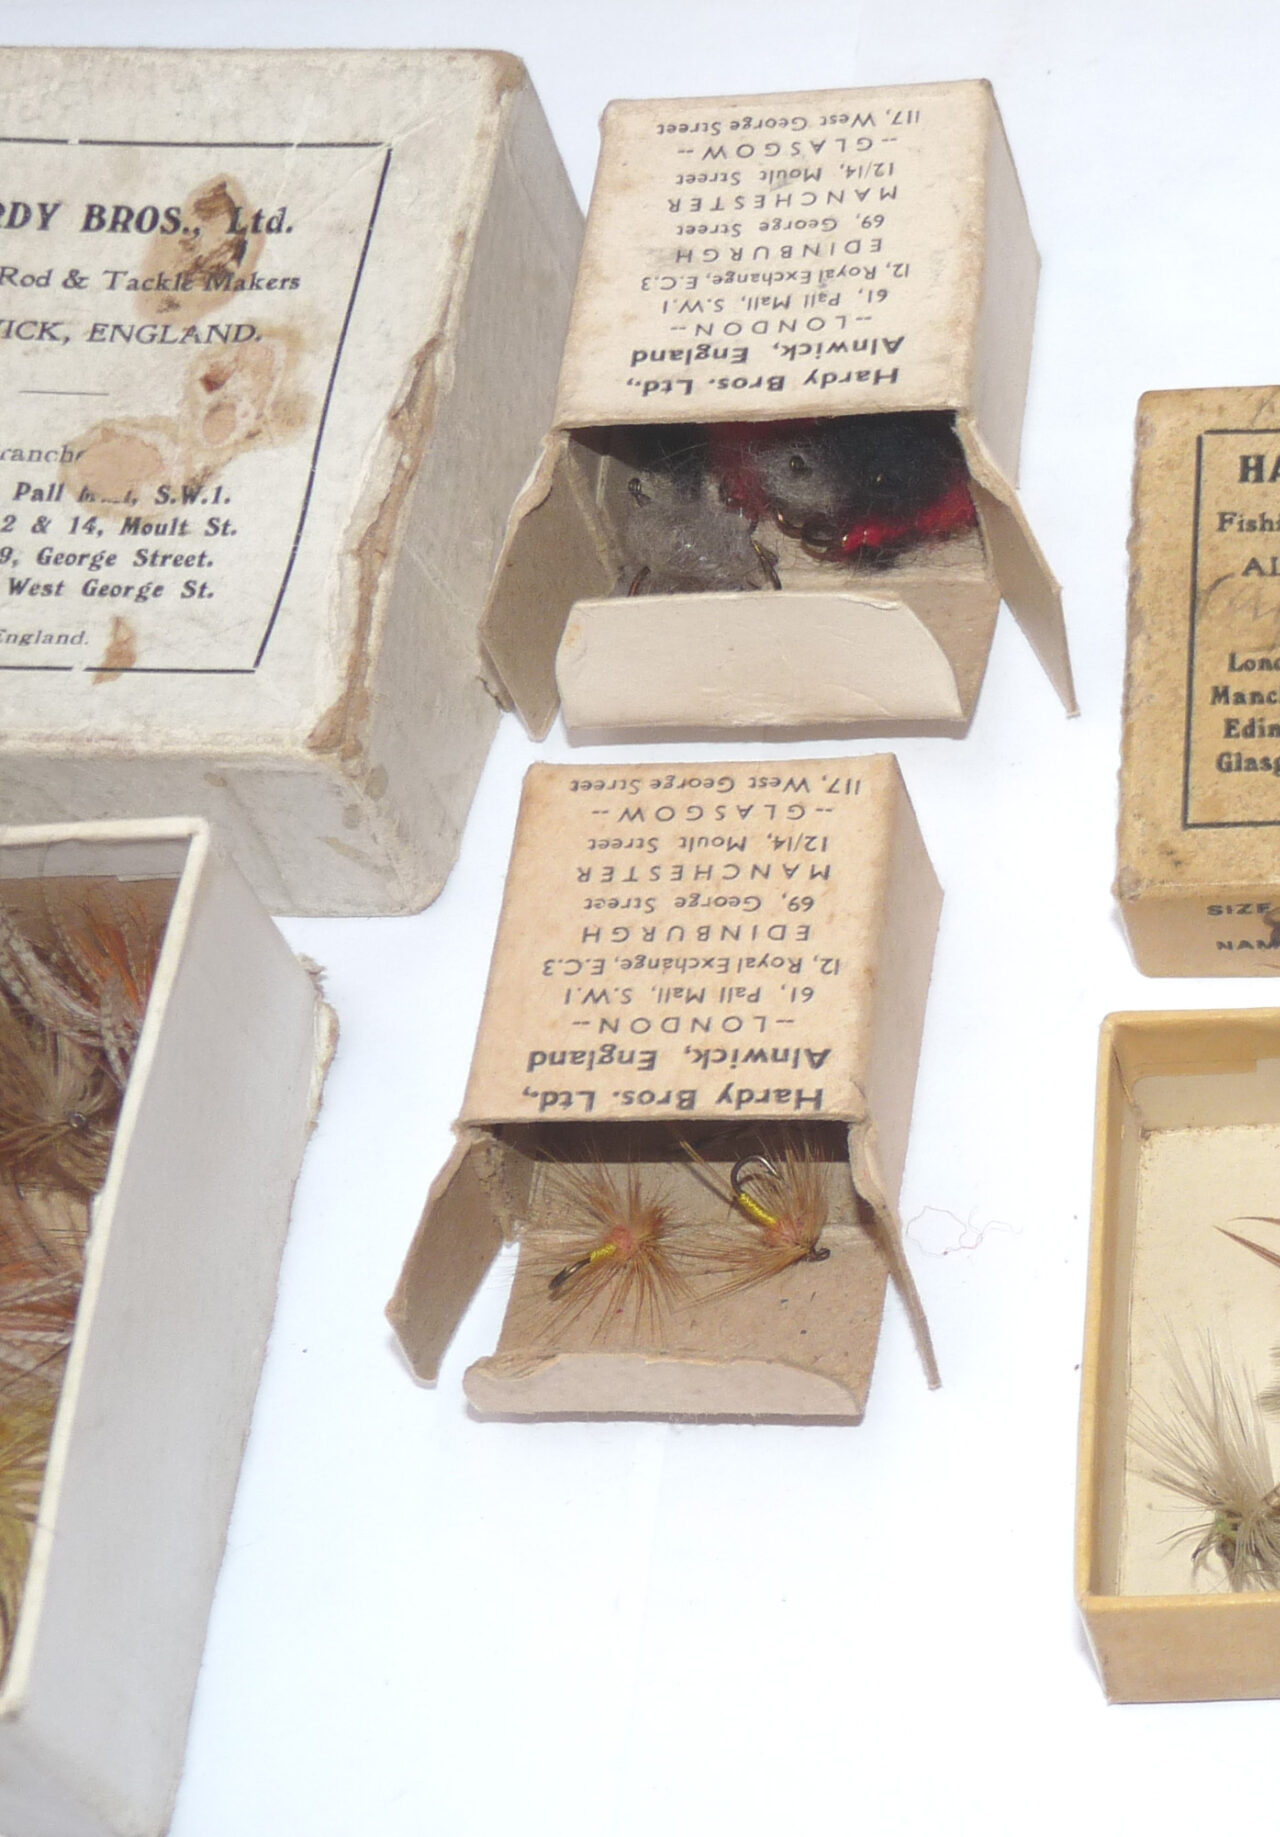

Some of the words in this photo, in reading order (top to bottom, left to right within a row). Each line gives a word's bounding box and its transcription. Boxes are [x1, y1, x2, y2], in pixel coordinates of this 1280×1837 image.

[730, 116, 808, 131] George
[820, 113, 876, 128] West
[886, 109, 920, 125] 117,
[657, 121, 721, 136] Street
[676, 172, 740, 186] Street
[760, 167, 822, 184] Moult
[840, 162, 894, 179] 12/14,
[668, 185, 897, 213] MANCHESTER
[80, 203, 201, 237] BROS.,
[225, 205, 294, 235] Ltd.
[759, 218, 837, 232] George
[856, 214, 885, 229] 69,
[677, 223, 742, 238] Street
[675, 238, 882, 264] EDINBURGH
[0, 266, 53, 288] Rod
[62, 269, 89, 289] &
[103, 269, 193, 291] Tackle
[203, 270, 300, 292] Makers
[706, 270, 811, 286] Exchange,
[818, 265, 876, 283] Royal
[886, 262, 910, 278] 12,
[741, 295, 791, 311] Mall,
[804, 292, 841, 308] Pall
[859, 288, 888, 303] 61,
[86, 322, 262, 344] ENGLAND.
[631, 344, 749, 367] England
[773, 336, 905, 361] Alnwick,
[627, 378, 693, 397] Ltd.,
[709, 376, 785, 391] Bros.
[804, 368, 899, 389] Hardy
[12, 482, 64, 502] Pall
[31, 515, 51, 534] &
[70, 516, 103, 537] 14,
[120, 516, 188, 536] Moult
[204, 517, 237, 536] St.
[36, 547, 117, 571] George
[133, 549, 213, 568] Street.
[9, 577, 64, 596] West
[82, 578, 164, 602] George
[181, 580, 213, 598] St.
[570, 779, 641, 795] Street
[650, 775, 735, 793] George
[749, 776, 810, 793] West
[822, 775, 860, 795] 117,
[588, 837, 659, 854] Street
[679, 836, 747, 853] Moult
[767, 833, 828, 852] 12/14,
[577, 864, 831, 883] MANCHESTER
[584, 897, 656, 914] Street
[674, 893, 762, 912] George
[782, 893, 814, 912] 69,
[582, 924, 810, 943] EDINBURGH
[615, 954, 730, 974] Exchange,
[737, 953, 802, 974] Royal
[813, 955, 840, 975] 12,
[652, 987, 706, 1004] Mall,
[720, 987, 761, 1003] Pall
[781, 984, 814, 1003] 61,
[527, 1044, 657, 1072] England
[684, 1045, 831, 1070] Alnwick,
[522, 1086, 595, 1110] Ltd.,
[613, 1089, 697, 1110] Bros.
[716, 1082, 823, 1109] Hardy
